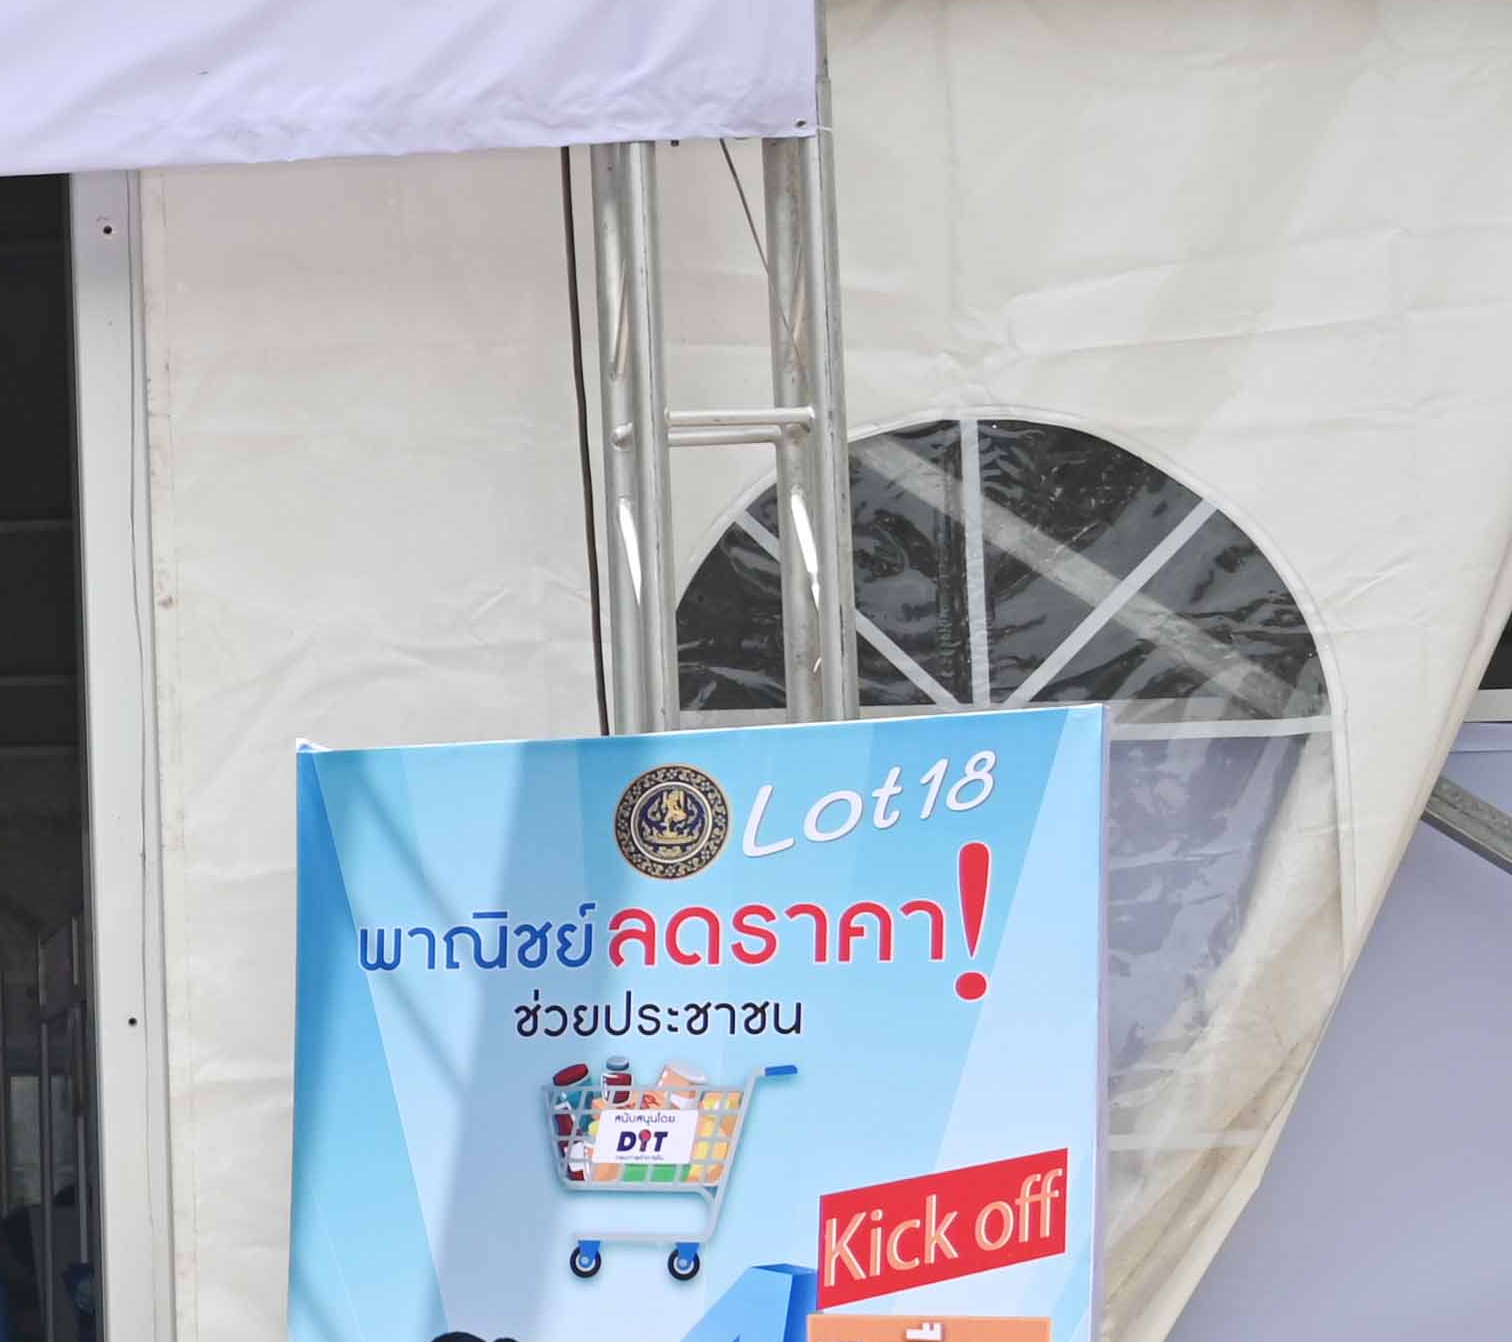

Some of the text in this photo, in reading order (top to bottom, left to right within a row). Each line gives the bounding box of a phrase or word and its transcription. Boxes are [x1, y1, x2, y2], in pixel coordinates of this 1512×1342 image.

[513, 988, 803, 1038] ช่วยประชาชน
[615, 1128, 669, 1153] DIT
[822, 1167, 1064, 1287] Kick off
